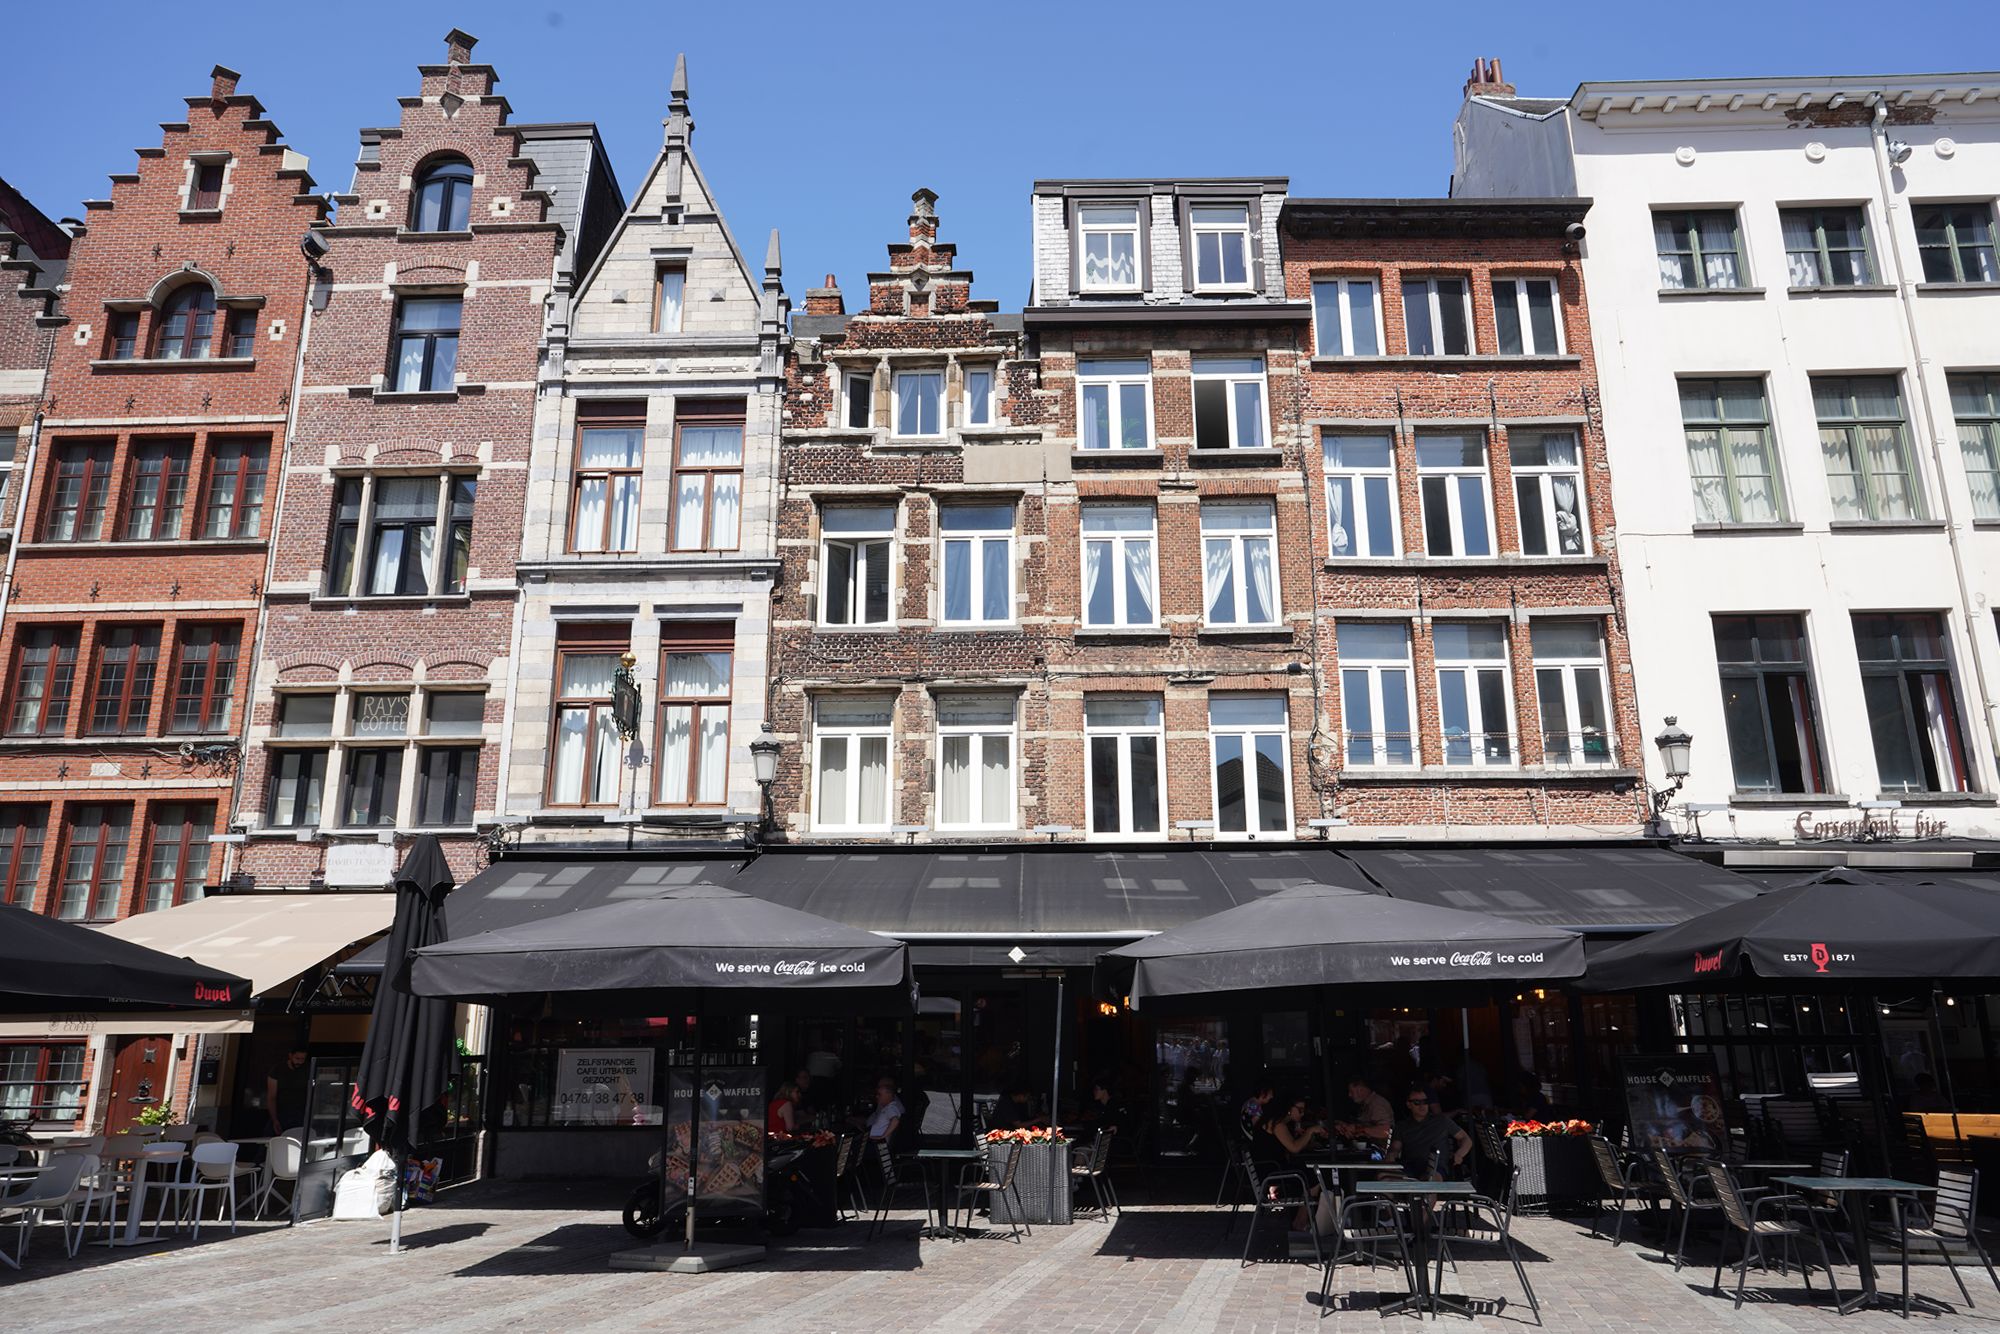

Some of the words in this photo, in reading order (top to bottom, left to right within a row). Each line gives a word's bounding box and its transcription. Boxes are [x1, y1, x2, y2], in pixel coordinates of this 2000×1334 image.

[363, 696, 409, 715] RAY'S
[361, 715, 408, 731] COFFEE
[1795, 808, 1901, 838] Corsendonk
[1915, 810, 1948, 837] bier
[1390, 956, 1410, 966] We
[1413, 956, 1446, 966] serve
[1497, 953, 1514, 963] ice
[1518, 953, 1544, 963] cold
[1694, 949, 1723, 973] Duvel
[716, 962, 735, 972] We
[737, 964, 771, 973] serve
[820, 962, 837, 973] ice
[840, 962, 865, 973] cold
[195, 981, 231, 1002] Duvel
[577, 1058, 635, 1066] ZELFSTANDIGE
[576, 1067, 598, 1075] CAFE
[599, 1067, 637, 1075] UITBATER
[582, 1076, 620, 1084] GEZOCHT
[1627, 1076, 1657, 1084] HOUSE
[1675, 1075, 1712, 1083] WAFFLES
[674, 1088, 704, 1098] HOUE
[724, 1087, 761, 1096] WAFFLES
[595, 1093, 609, 1104] 38
[613, 1093, 626, 1104] 47
